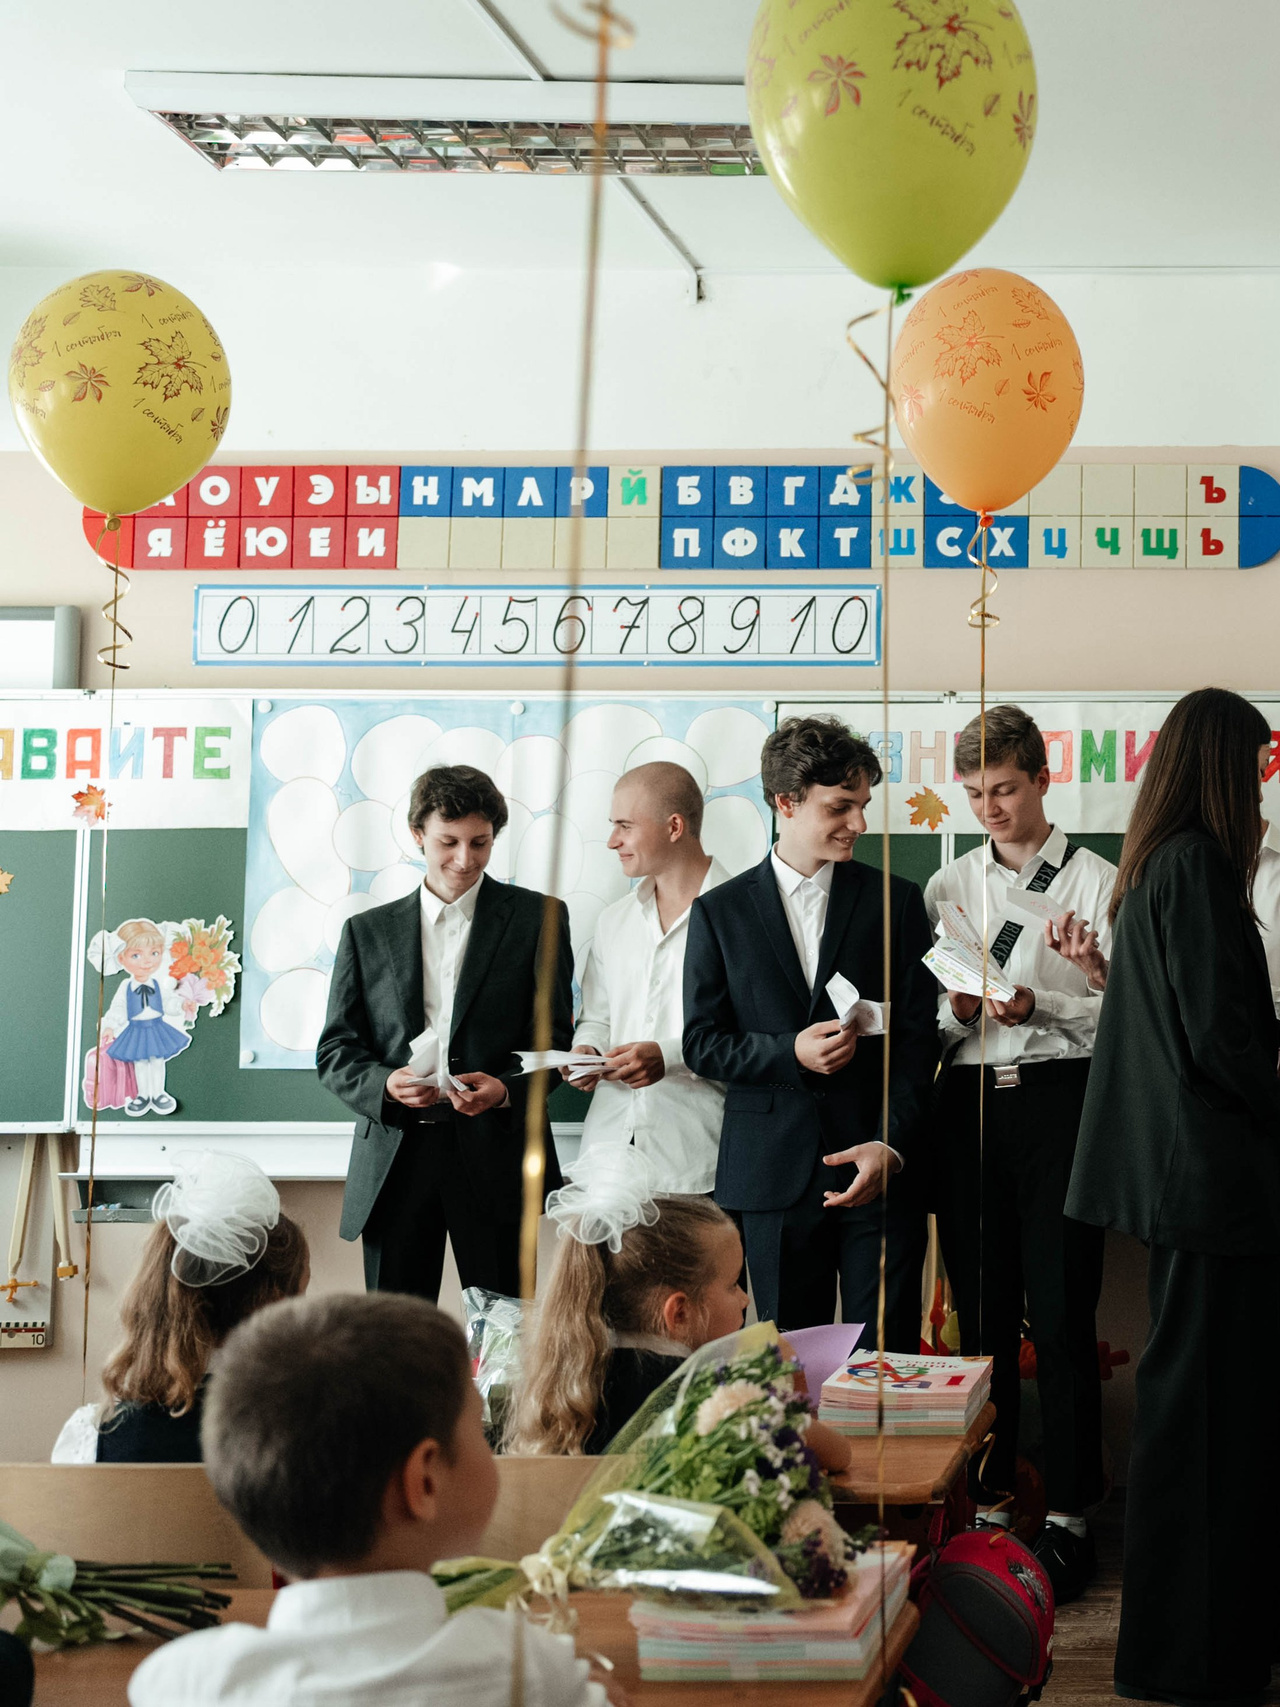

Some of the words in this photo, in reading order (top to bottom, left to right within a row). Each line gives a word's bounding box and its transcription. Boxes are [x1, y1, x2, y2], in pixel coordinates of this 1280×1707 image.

[900, 89, 912, 107] 1
[141, 313, 153, 329] 1
[938, 307, 947, 318] 1
[52, 340, 61, 357] 1
[66, 325, 122, 353] сентября
[1011, 343, 1021, 361] 1
[939, 388, 947, 402] 1
[948, 398, 995, 424] сентября
[133, 397, 146, 408] 1
[142, 408, 184, 444] сентября
[218, 595, 256, 654] 0
[288, 595, 316, 655] 1
[330, 595, 370, 655] 2
[384, 595, 426, 654] 3
[451, 595, 480, 655] 4
[494, 596, 538, 655] 5
[552, 595, 593, 655] 6
[614, 596, 650, 655] 7
[667, 595, 704, 654] 8
[723, 595, 760, 654] 9
[31, 1333, 45, 1346] 10
